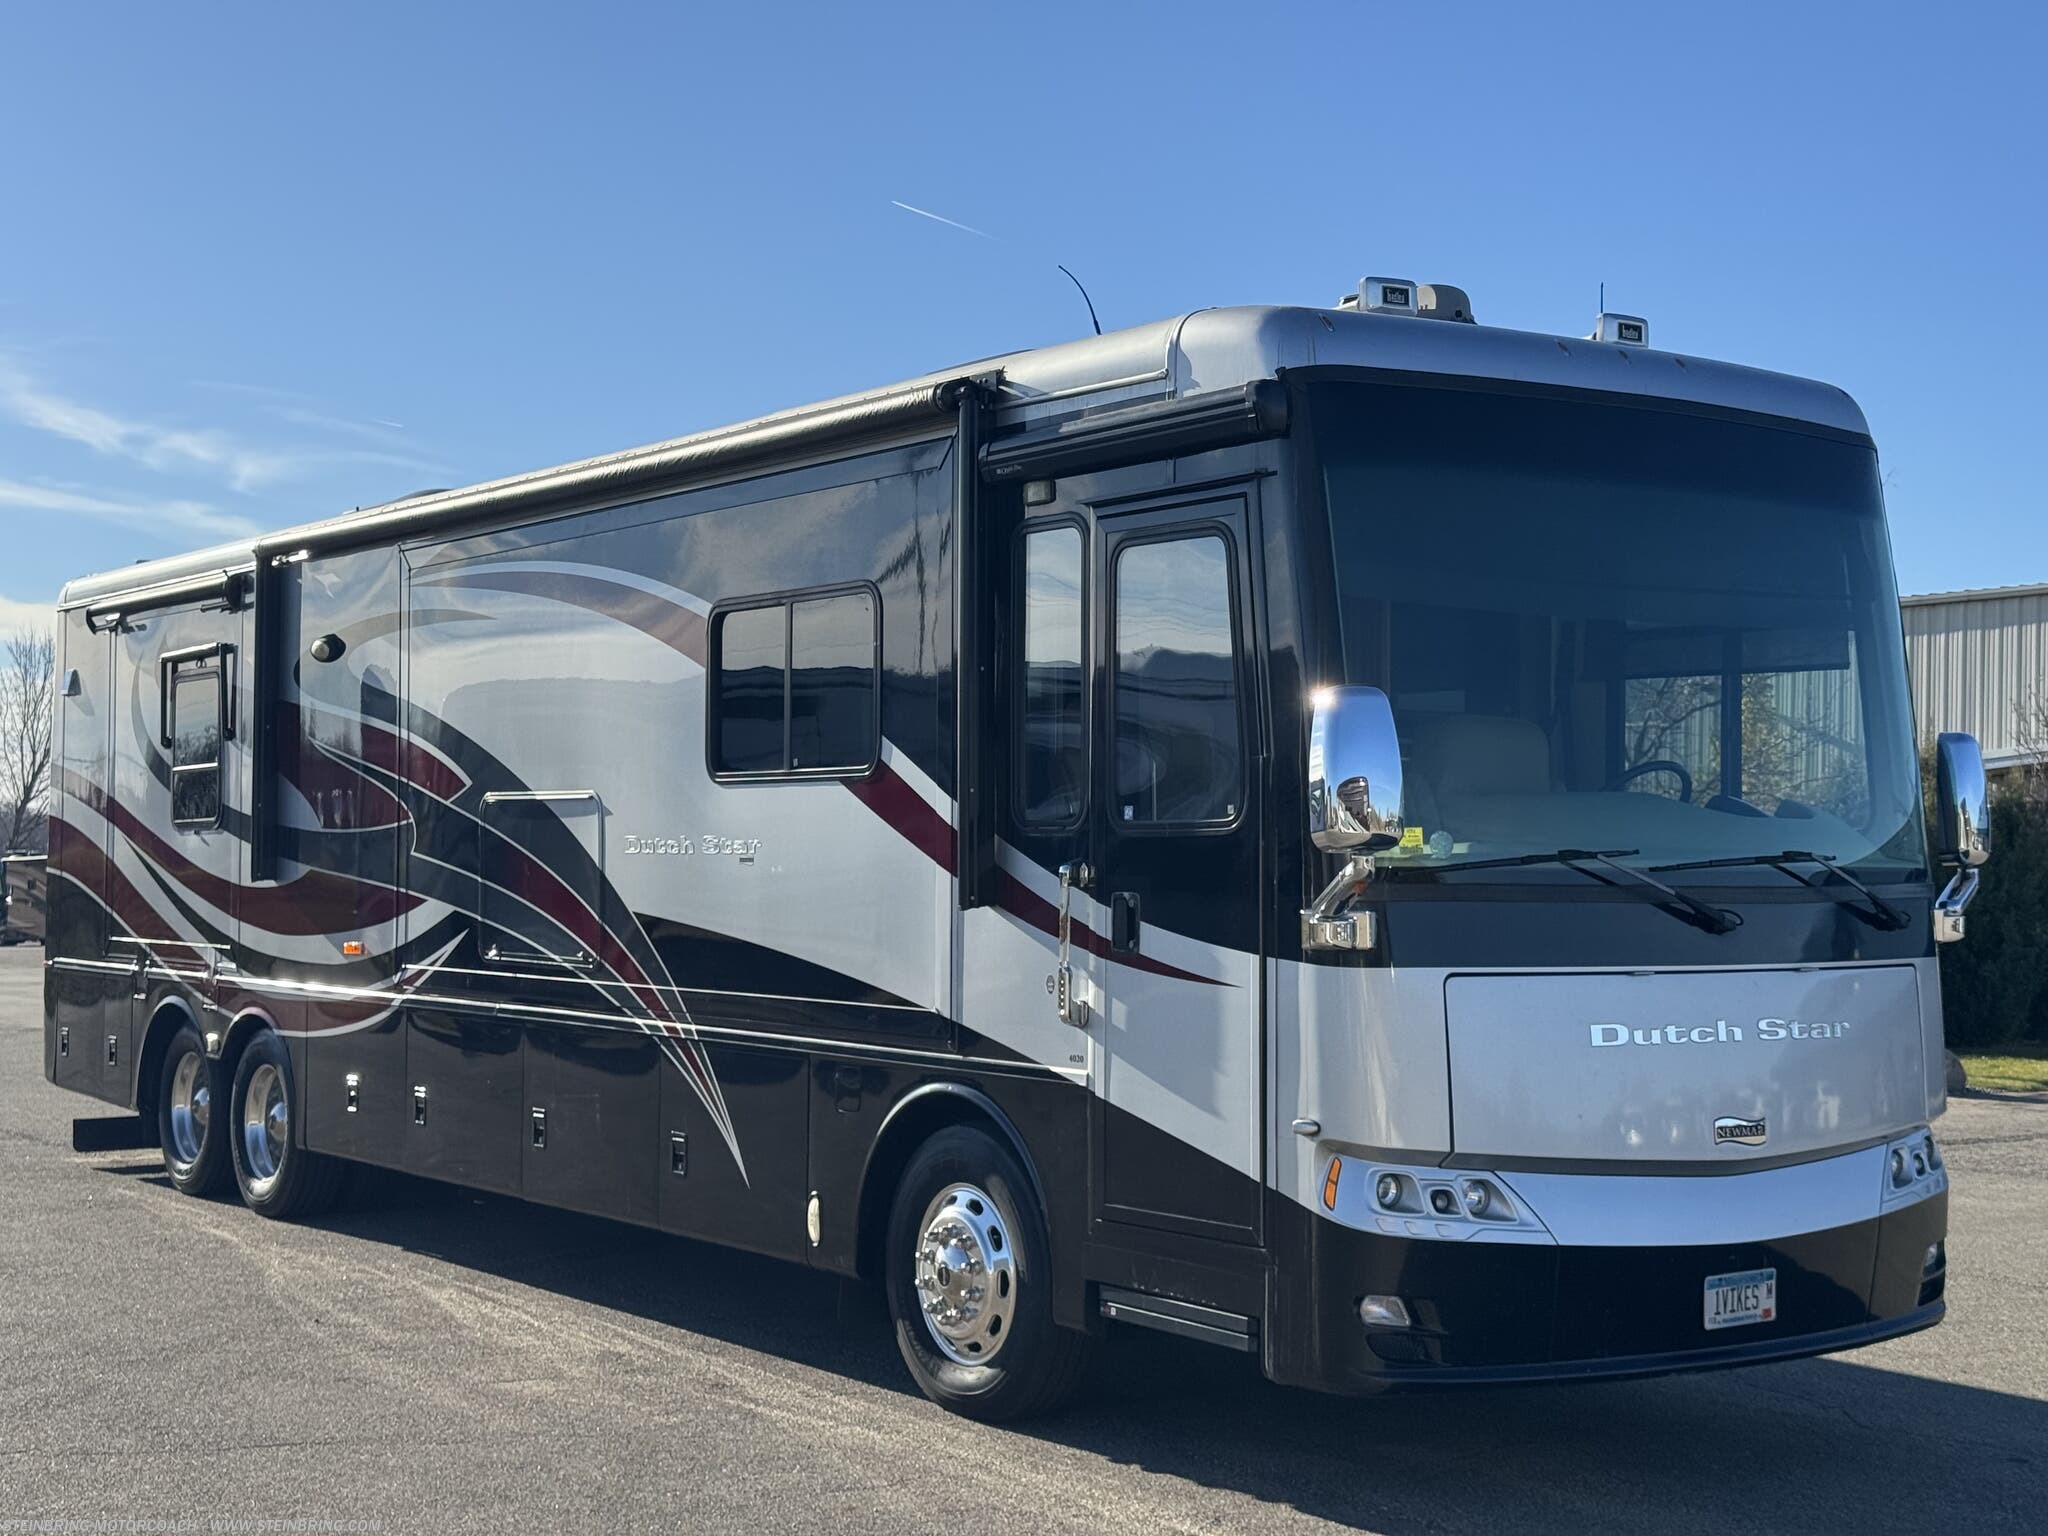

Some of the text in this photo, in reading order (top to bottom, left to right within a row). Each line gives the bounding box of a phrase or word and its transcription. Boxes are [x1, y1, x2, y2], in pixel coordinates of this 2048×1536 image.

[623, 834, 762, 855] Dutch Star
[1590, 1018, 1850, 1047] Dutch Star
[1717, 1125, 1765, 1138] NEWMAR
[1714, 1284, 1760, 1316] 1VIKES
